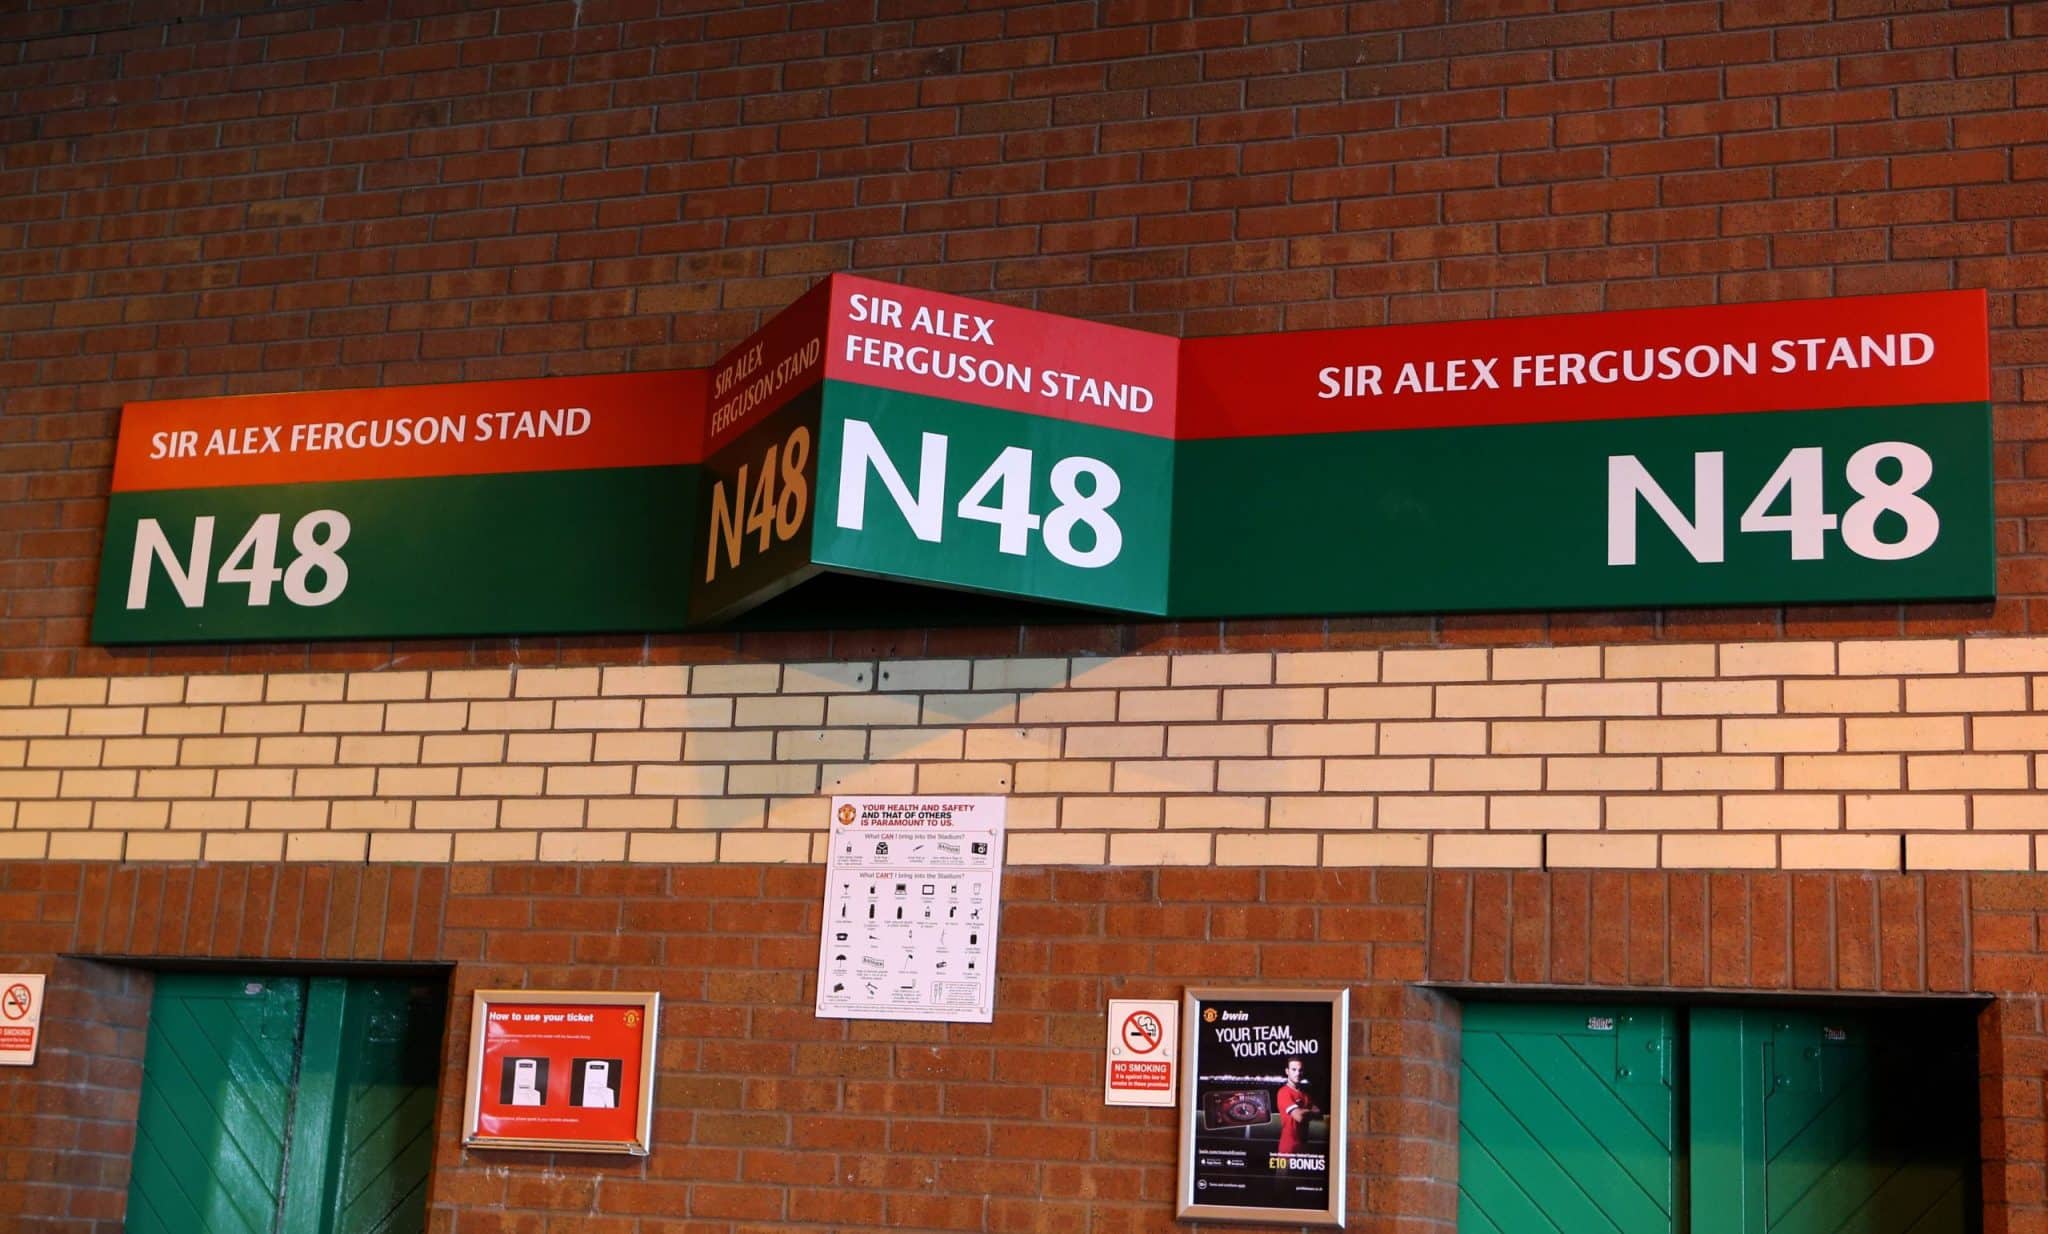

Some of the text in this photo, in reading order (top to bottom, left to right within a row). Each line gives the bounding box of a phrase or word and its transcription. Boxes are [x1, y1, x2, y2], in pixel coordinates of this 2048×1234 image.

[848, 293, 996, 346] SIR ALEX
[711, 337, 821, 438] FERGUSON STAND
[713, 340, 764, 400] SIR ALEX
[845, 334, 1154, 414] FERGUSON STAND
[1317, 332, 1935, 399] SIR ALEX FERGUSON STAND
[149, 407, 592, 460] SIR ALEX FERGUSON STAND
[706, 425, 811, 584] N48
[836, 417, 1123, 569] N48
[1606, 440, 1940, 567] N48
[126, 509, 351, 610] N48
[942, 804, 975, 812] SAFETY
[489, 1012, 594, 1023] How to use your ticket
[1216, 1025, 1293, 1042] YOUR TEAM,
[1222, 1010, 1249, 1021] bwin
[1115, 1063, 1167, 1073] NO SMOKING
[1231, 1039, 1319, 1058] YOUR CASINO
[1269, 1157, 1326, 1170] £10 BONUS
